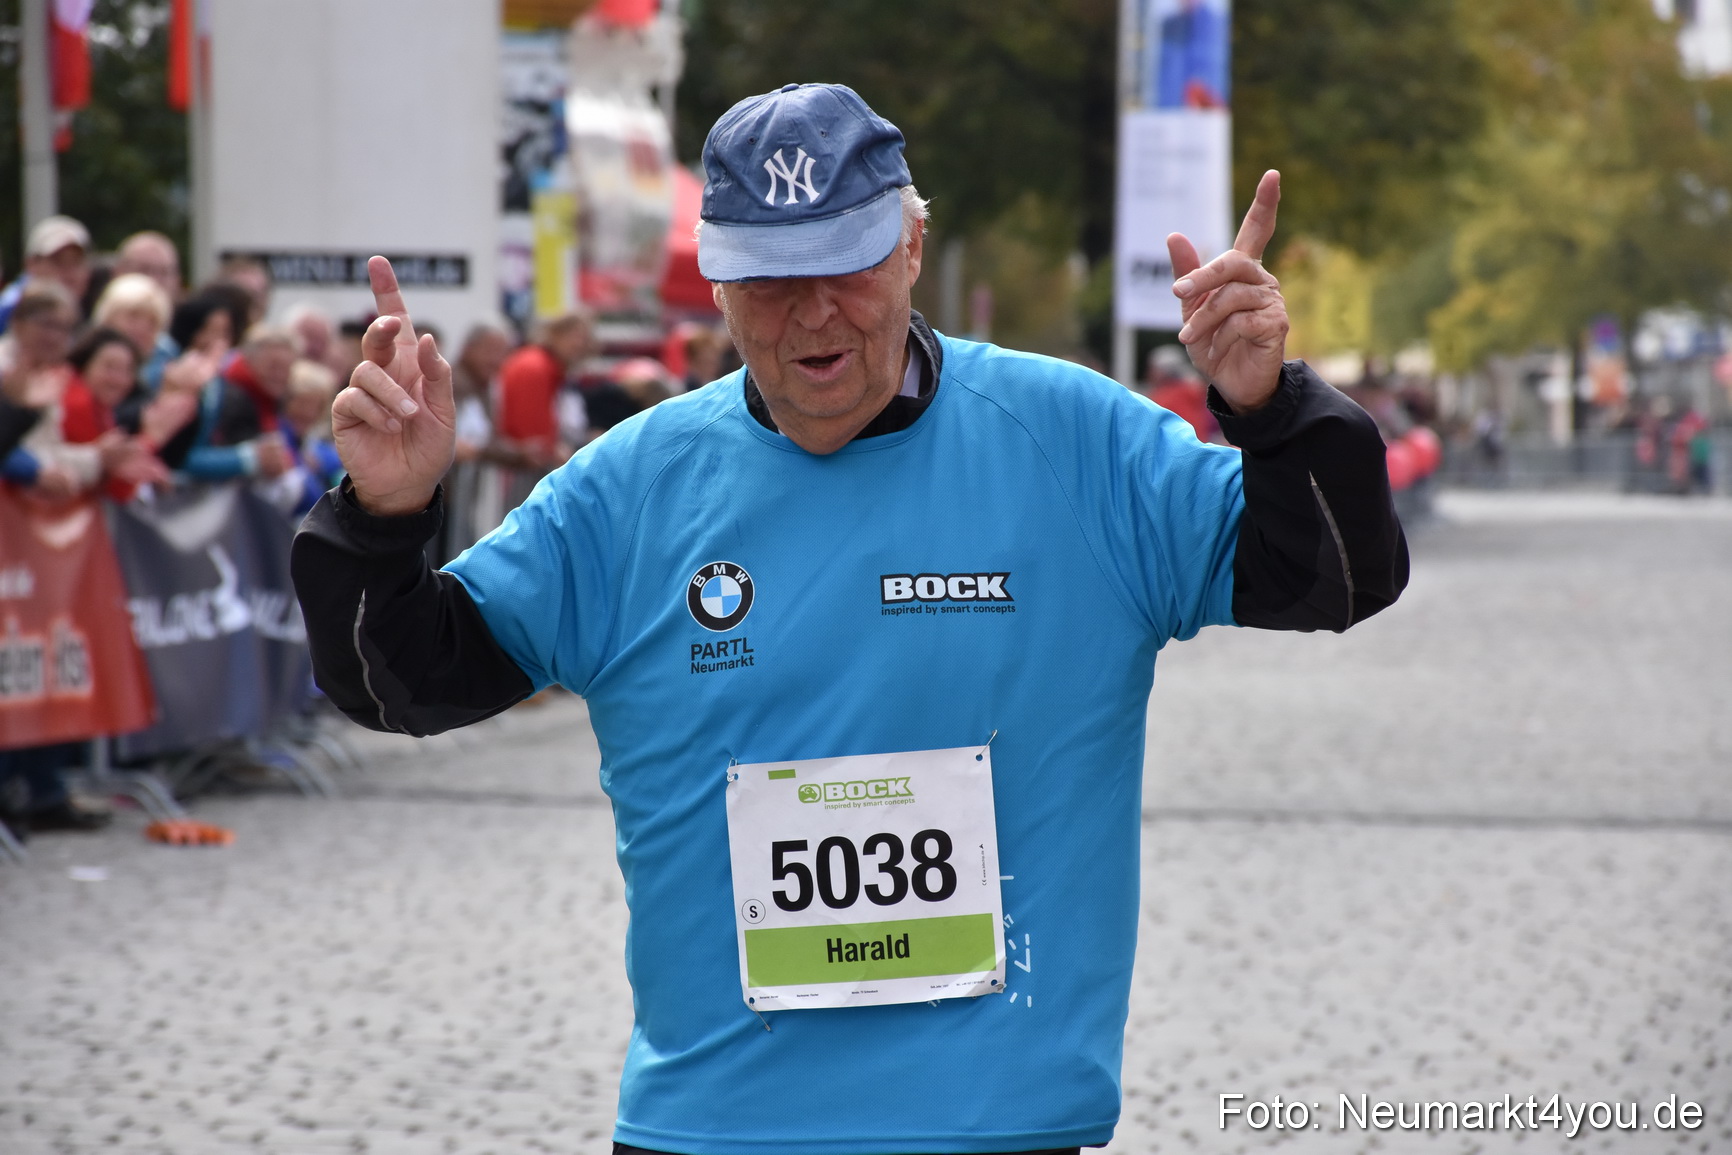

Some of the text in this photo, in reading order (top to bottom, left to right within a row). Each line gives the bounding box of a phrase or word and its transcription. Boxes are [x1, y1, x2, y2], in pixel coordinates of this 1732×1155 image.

[692, 563, 749, 588] BMW
[880, 572, 1014, 604] BOCK
[881, 604, 1016, 616] inspired by smart concepts
[690, 637, 754, 661] PARTL
[690, 655, 755, 674] Neumarkt
[823, 777, 914, 802] BOCK
[884, 798, 915, 806] concepts
[771, 829, 957, 912] 5038
[748, 905, 758, 919] S
[826, 933, 910, 963] Harald
